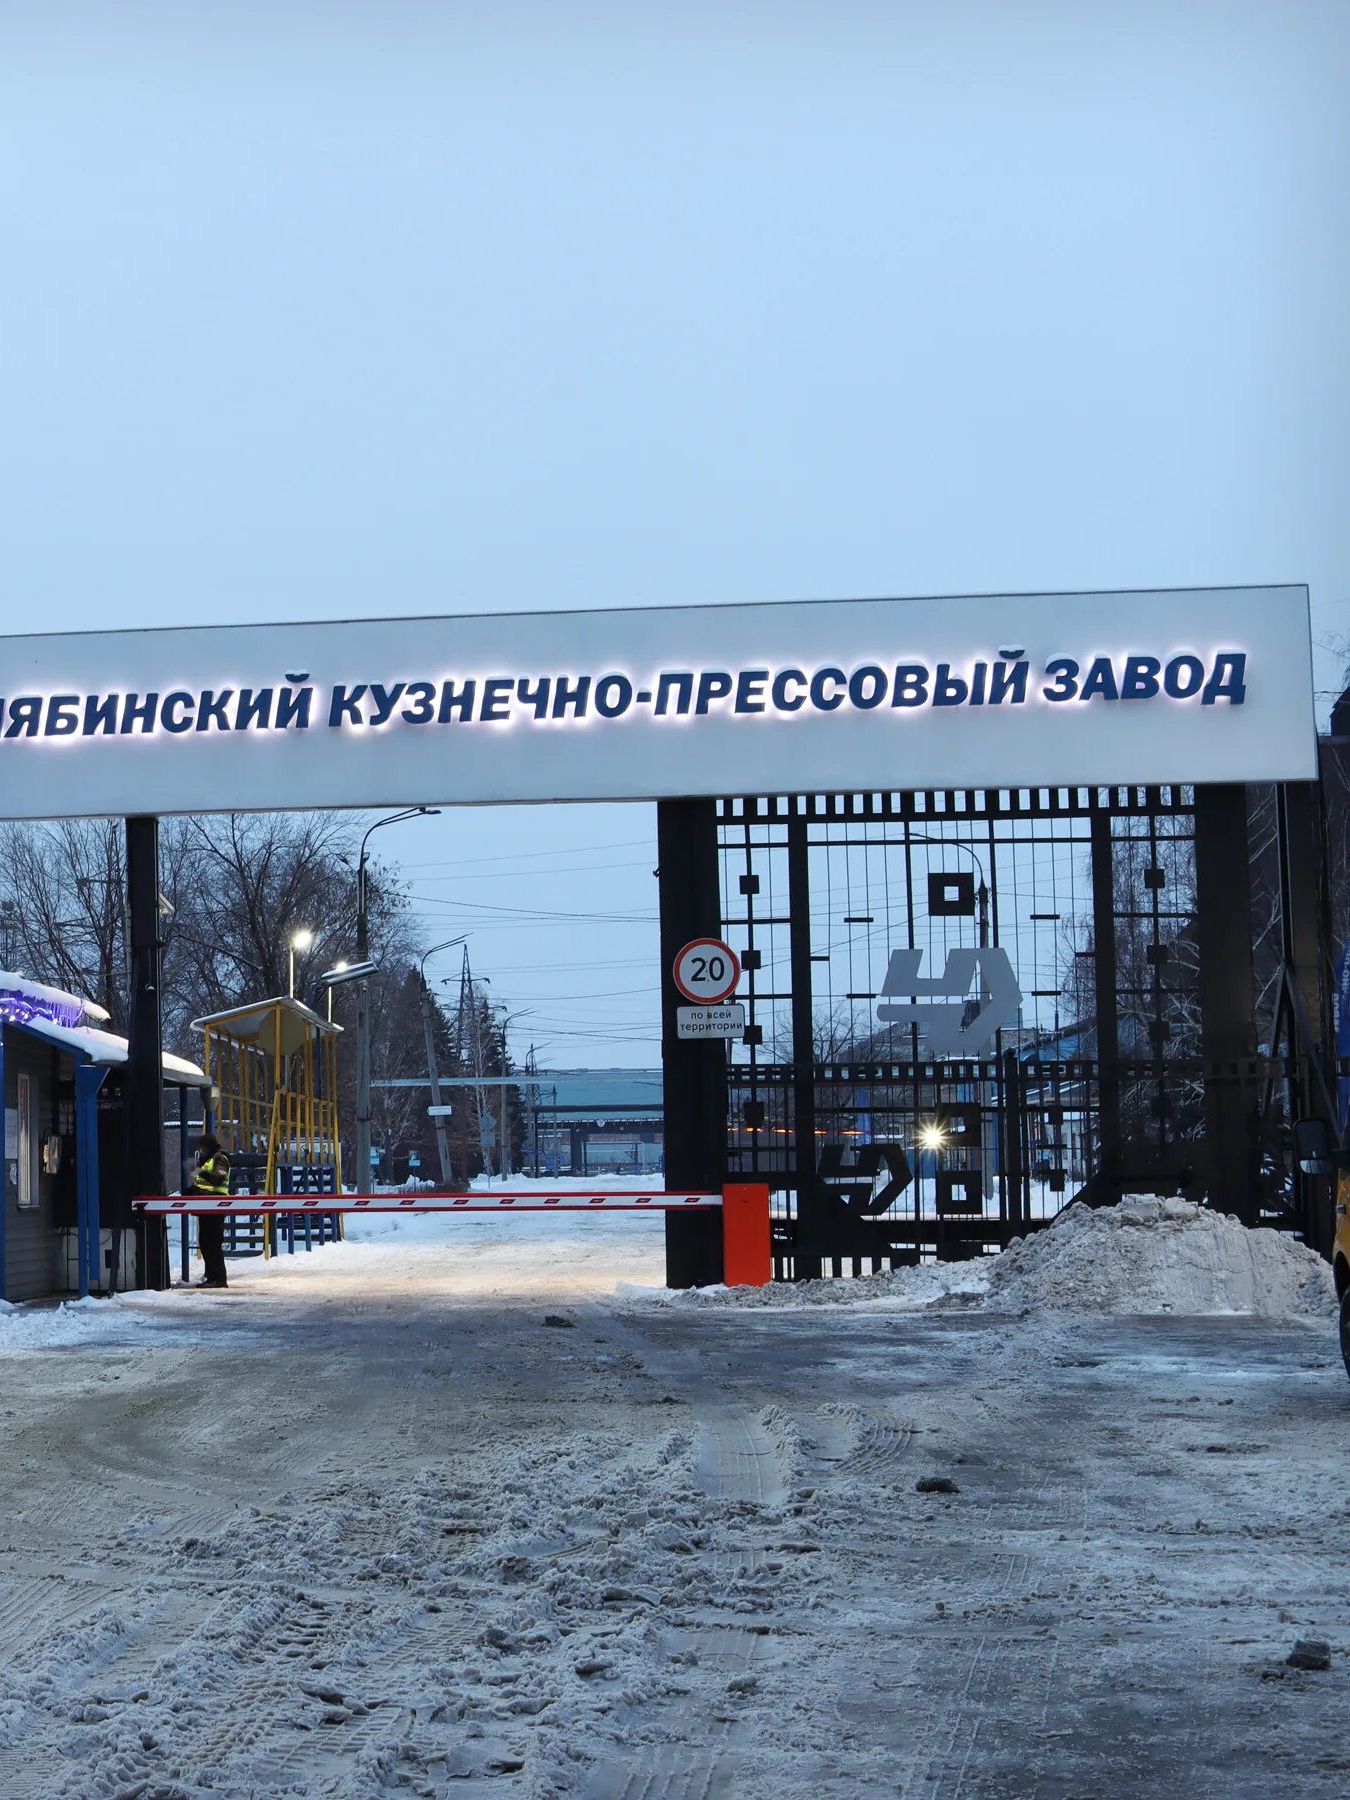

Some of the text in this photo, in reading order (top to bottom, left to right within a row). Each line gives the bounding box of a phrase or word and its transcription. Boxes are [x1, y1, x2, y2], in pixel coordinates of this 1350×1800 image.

[327, 646, 1029, 727] КУЗНЕЧНО-ПРЕССОВЫЙ
[1042, 651, 1247, 706] ЗАВОД
[690, 956, 725, 982] 20
[690, 1009, 732, 1019] по всей
[680, 1022, 743, 1032] территории
